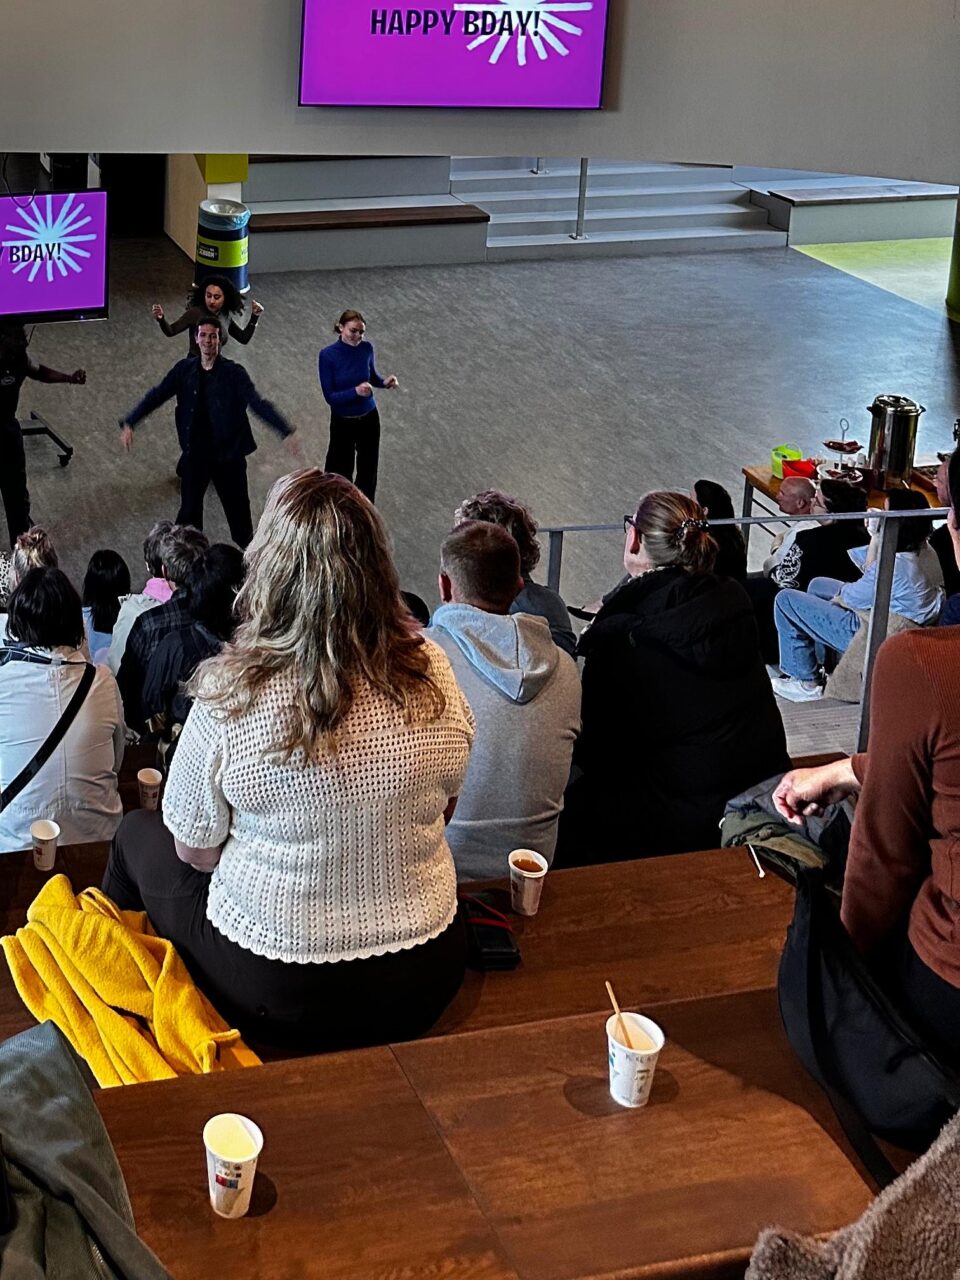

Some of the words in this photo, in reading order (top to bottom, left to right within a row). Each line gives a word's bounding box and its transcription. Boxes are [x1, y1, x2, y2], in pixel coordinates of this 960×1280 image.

[370, 9, 458, 35] HAPPY
[463, 10, 540, 37] BDAY!
[9, 242, 61, 263] BDAY!
